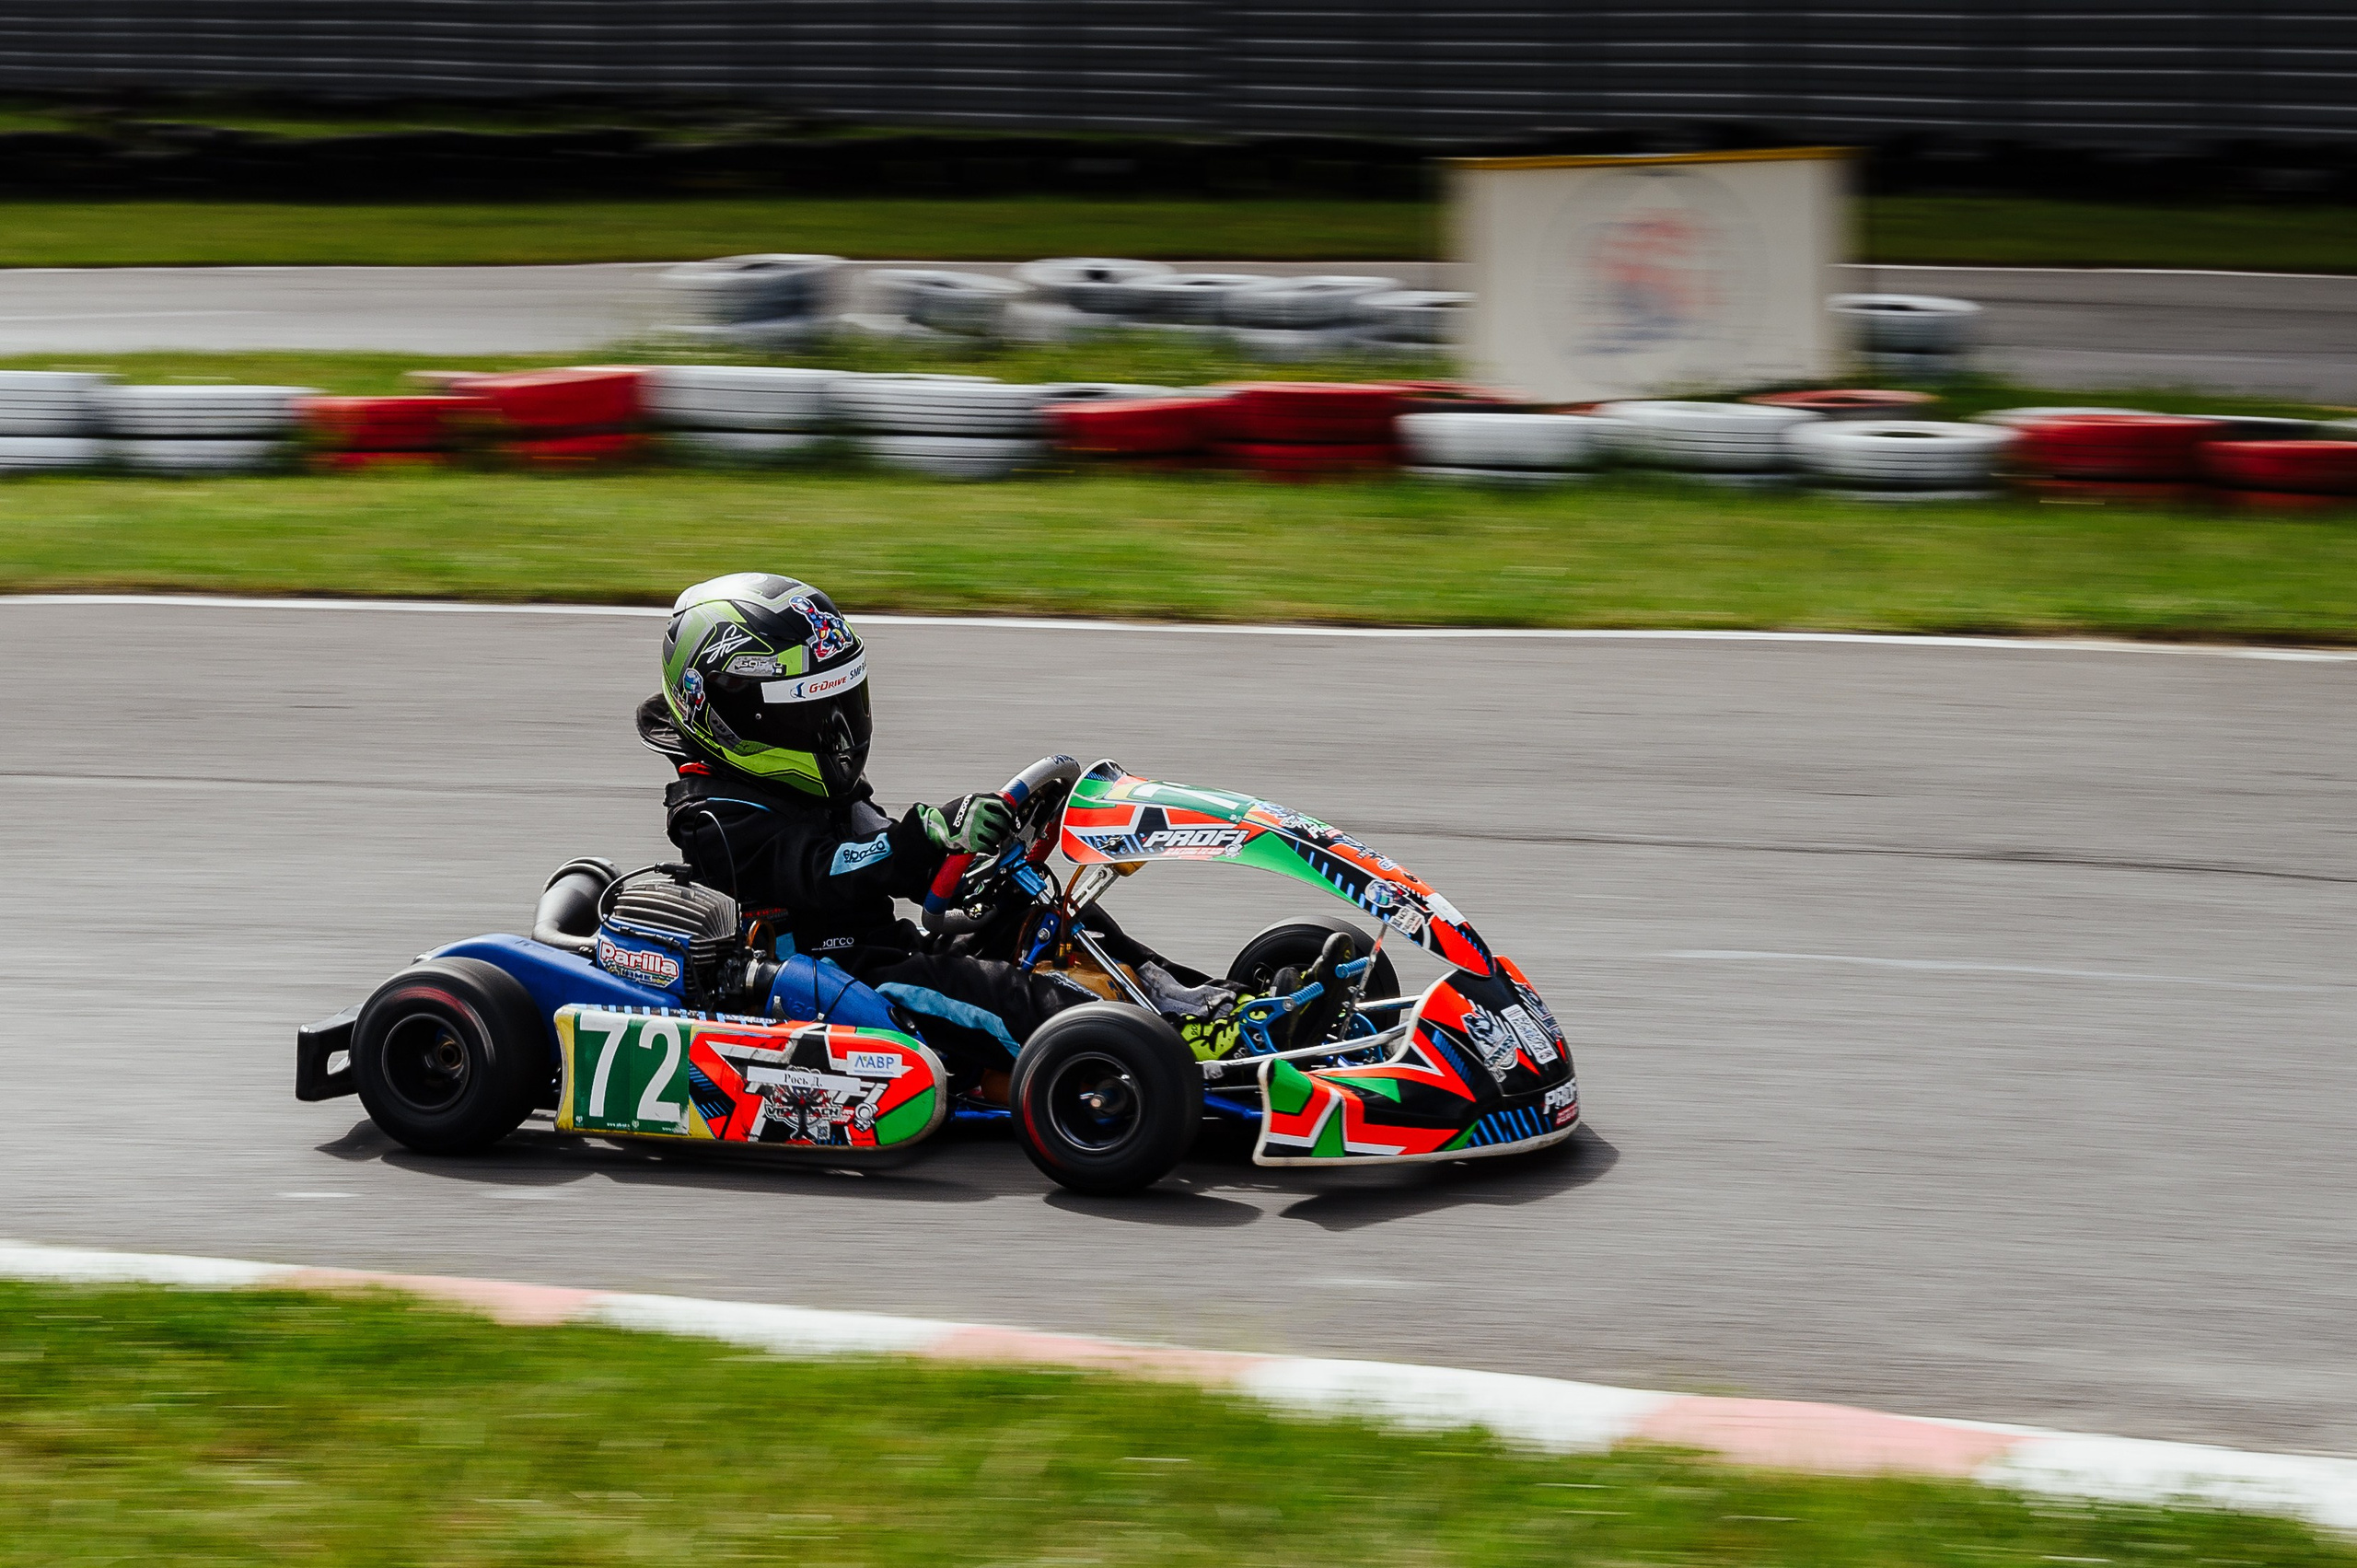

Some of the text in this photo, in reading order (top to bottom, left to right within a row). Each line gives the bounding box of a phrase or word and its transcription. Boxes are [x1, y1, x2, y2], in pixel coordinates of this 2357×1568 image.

[1143, 830, 1249, 847] PROFI
[843, 840, 886, 863] spaco
[822, 936, 854, 948] arco
[600, 941, 679, 978] Parilla
[579, 1012, 681, 1122] 72
[784, 1073, 808, 1086] Рось
